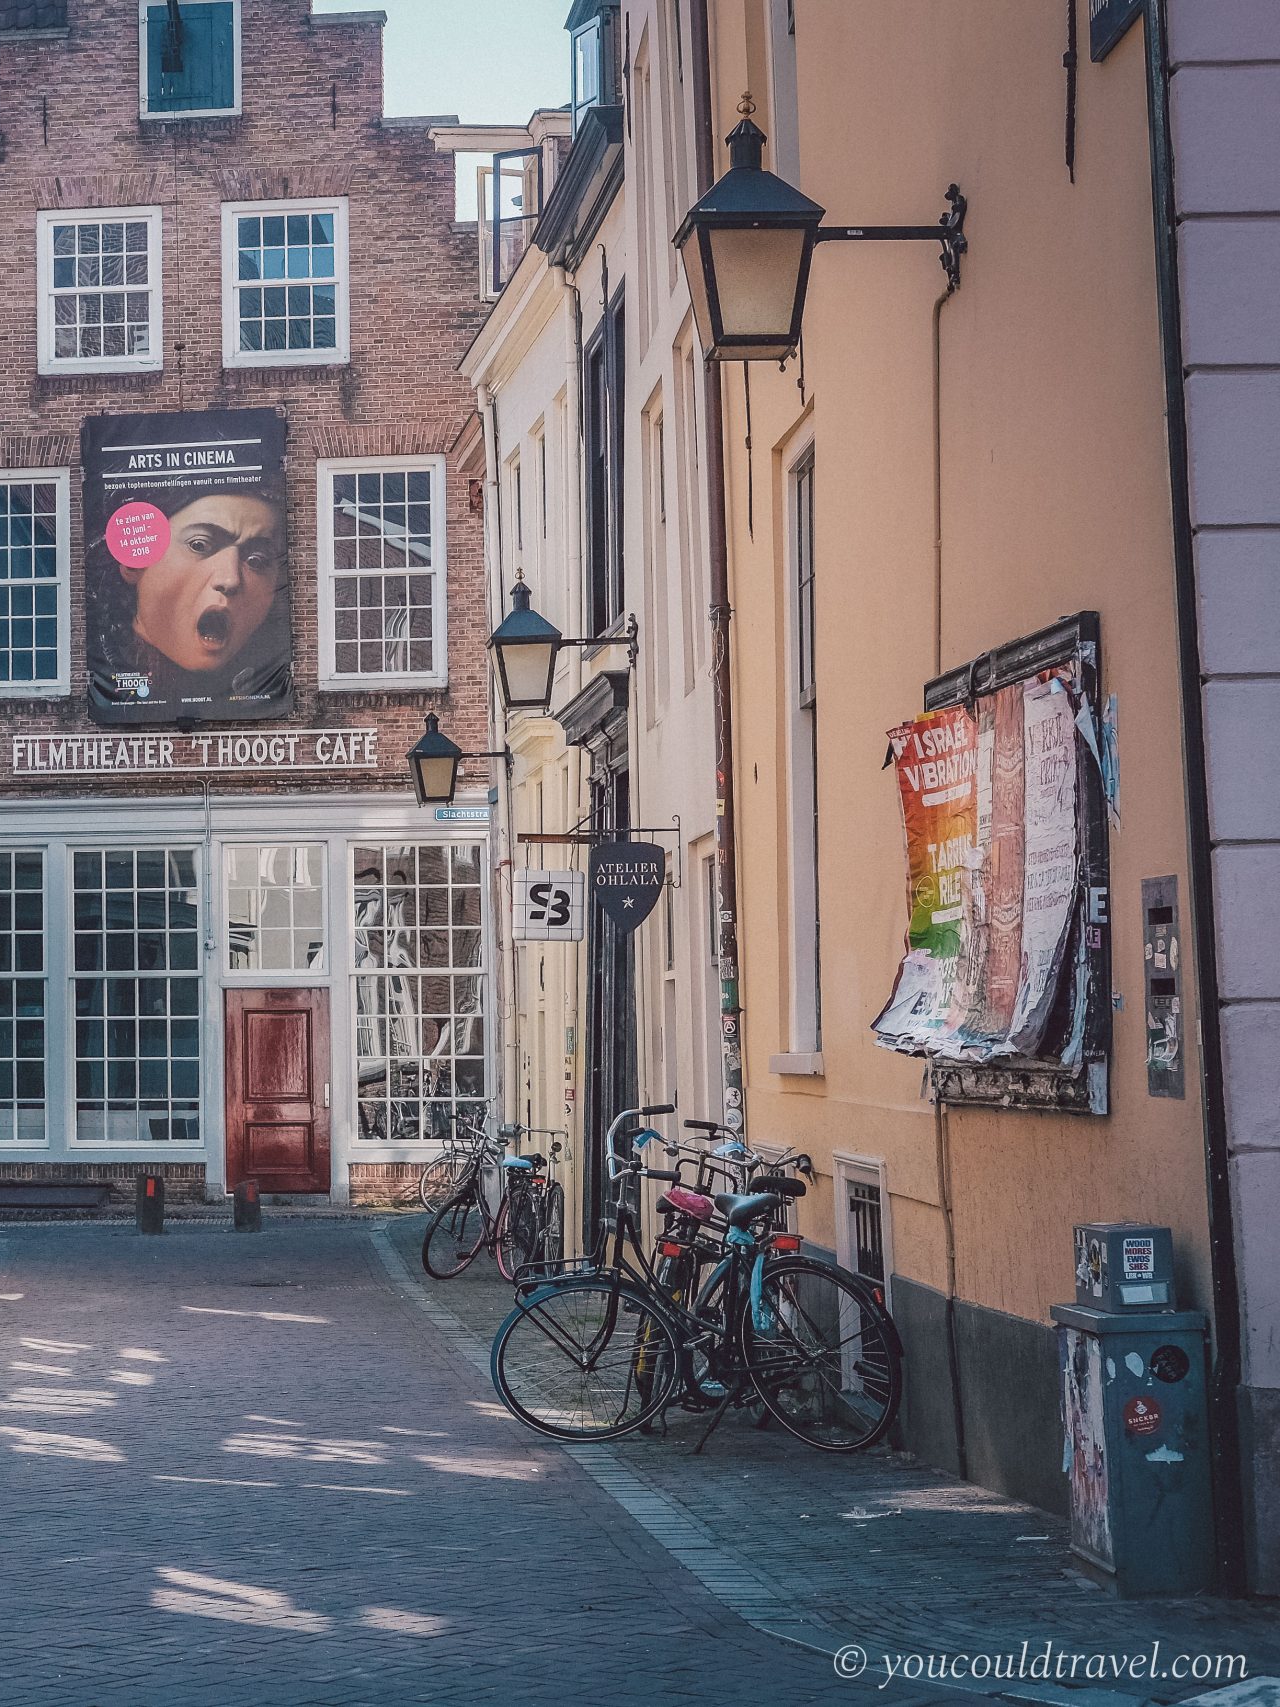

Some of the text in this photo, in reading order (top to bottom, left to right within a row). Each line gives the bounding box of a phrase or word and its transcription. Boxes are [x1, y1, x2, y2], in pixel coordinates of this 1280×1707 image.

[128, 450, 236, 469] ARTS IN CINEMA
[104, 482, 126, 490] bezoek
[193, 477, 212, 486] vanuit
[226, 475, 262, 484] filmtheater
[115, 512, 155, 526] te zien van
[123, 527, 131, 536] 10
[132, 523, 146, 536] juni
[120, 534, 158, 548] 14 oktober
[131, 546, 150, 557] 2018
[122, 678, 149, 688] HOOGT
[913, 717, 969, 759] ISRAEL
[13, 740, 174, 768] FILMTHEATER
[217, 737, 299, 764] HOOGT
[316, 732, 378, 762] CAFÉ
[903, 748, 978, 792] VIBRATION
[596, 862, 658, 875] ATELIER
[596, 874, 660, 886] OHLALA
[1125, 1240, 1151, 1248] WOOD
[1125, 1247, 1152, 1256] MORES
